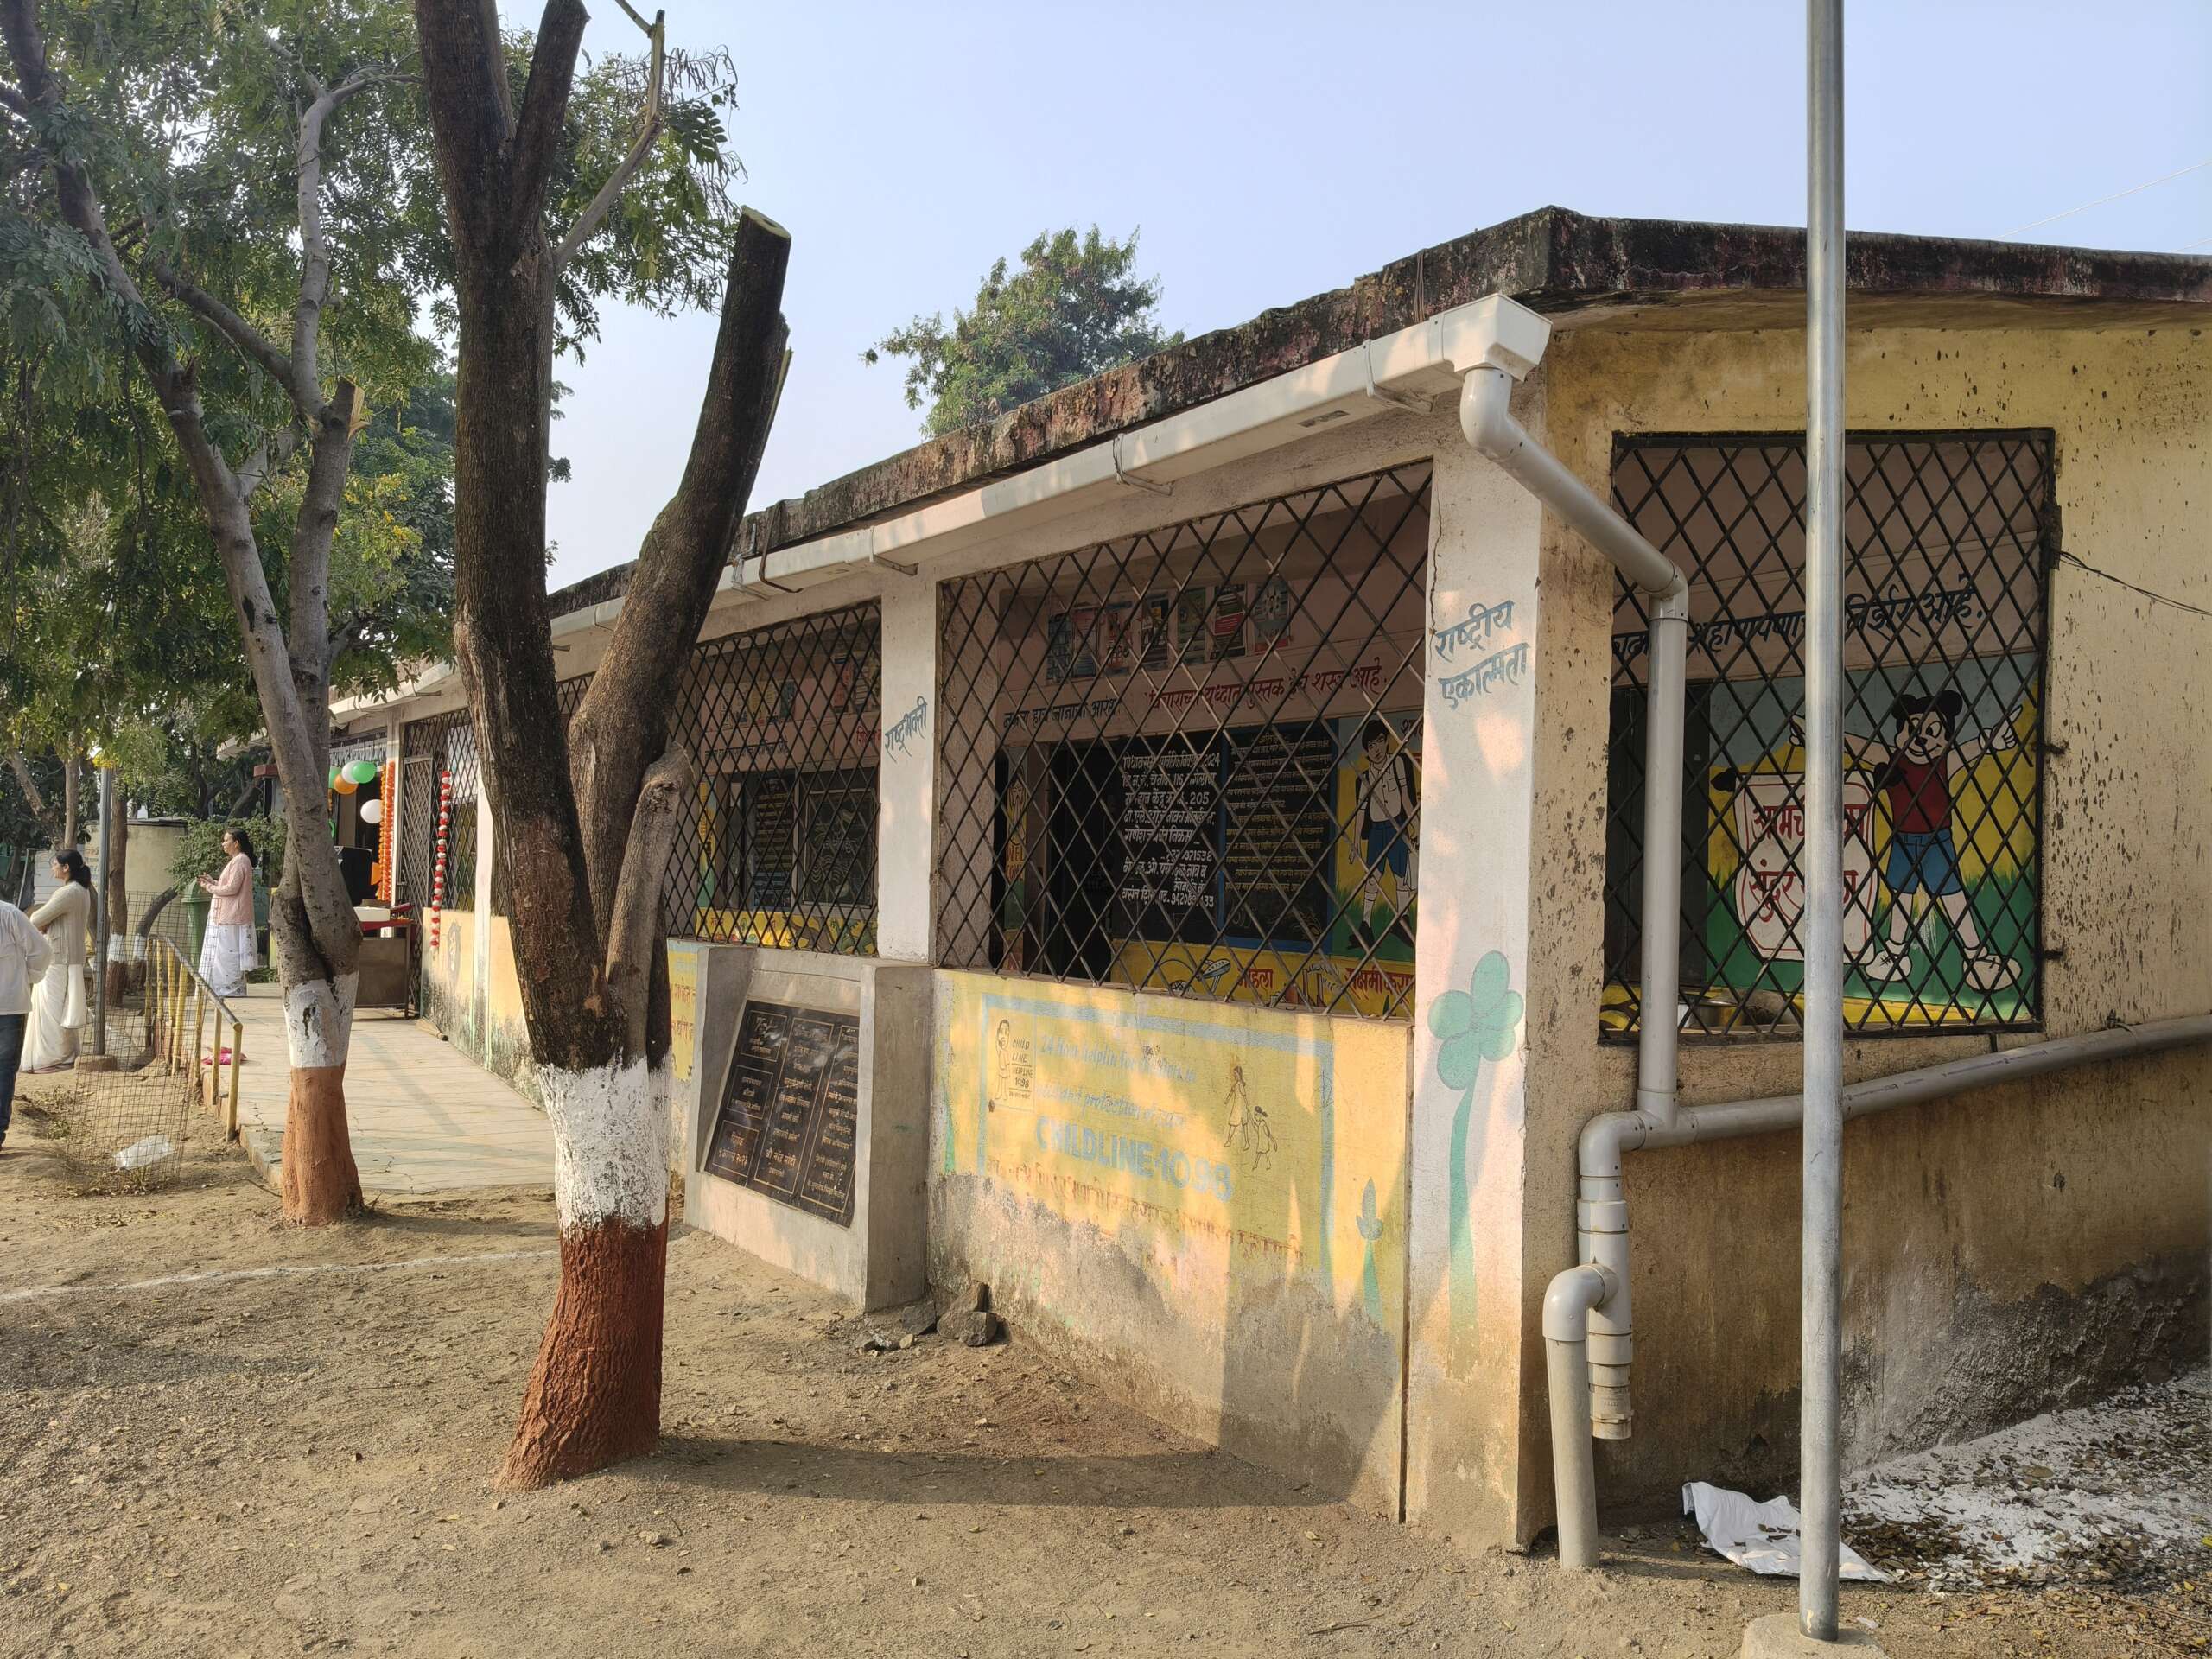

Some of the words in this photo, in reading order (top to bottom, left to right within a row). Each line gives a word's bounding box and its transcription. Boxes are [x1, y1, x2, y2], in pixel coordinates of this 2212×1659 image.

[1435, 600, 1515, 663] राष्ट्रीय
[1243, 678, 1286, 709] पुस्तक
[1349, 656, 1387, 696] आहे.
[1438, 642, 1529, 710] एकात्मता
[1189, 791, 1210, 805] 205
[1012, 1052, 1028, 1064] LINE
